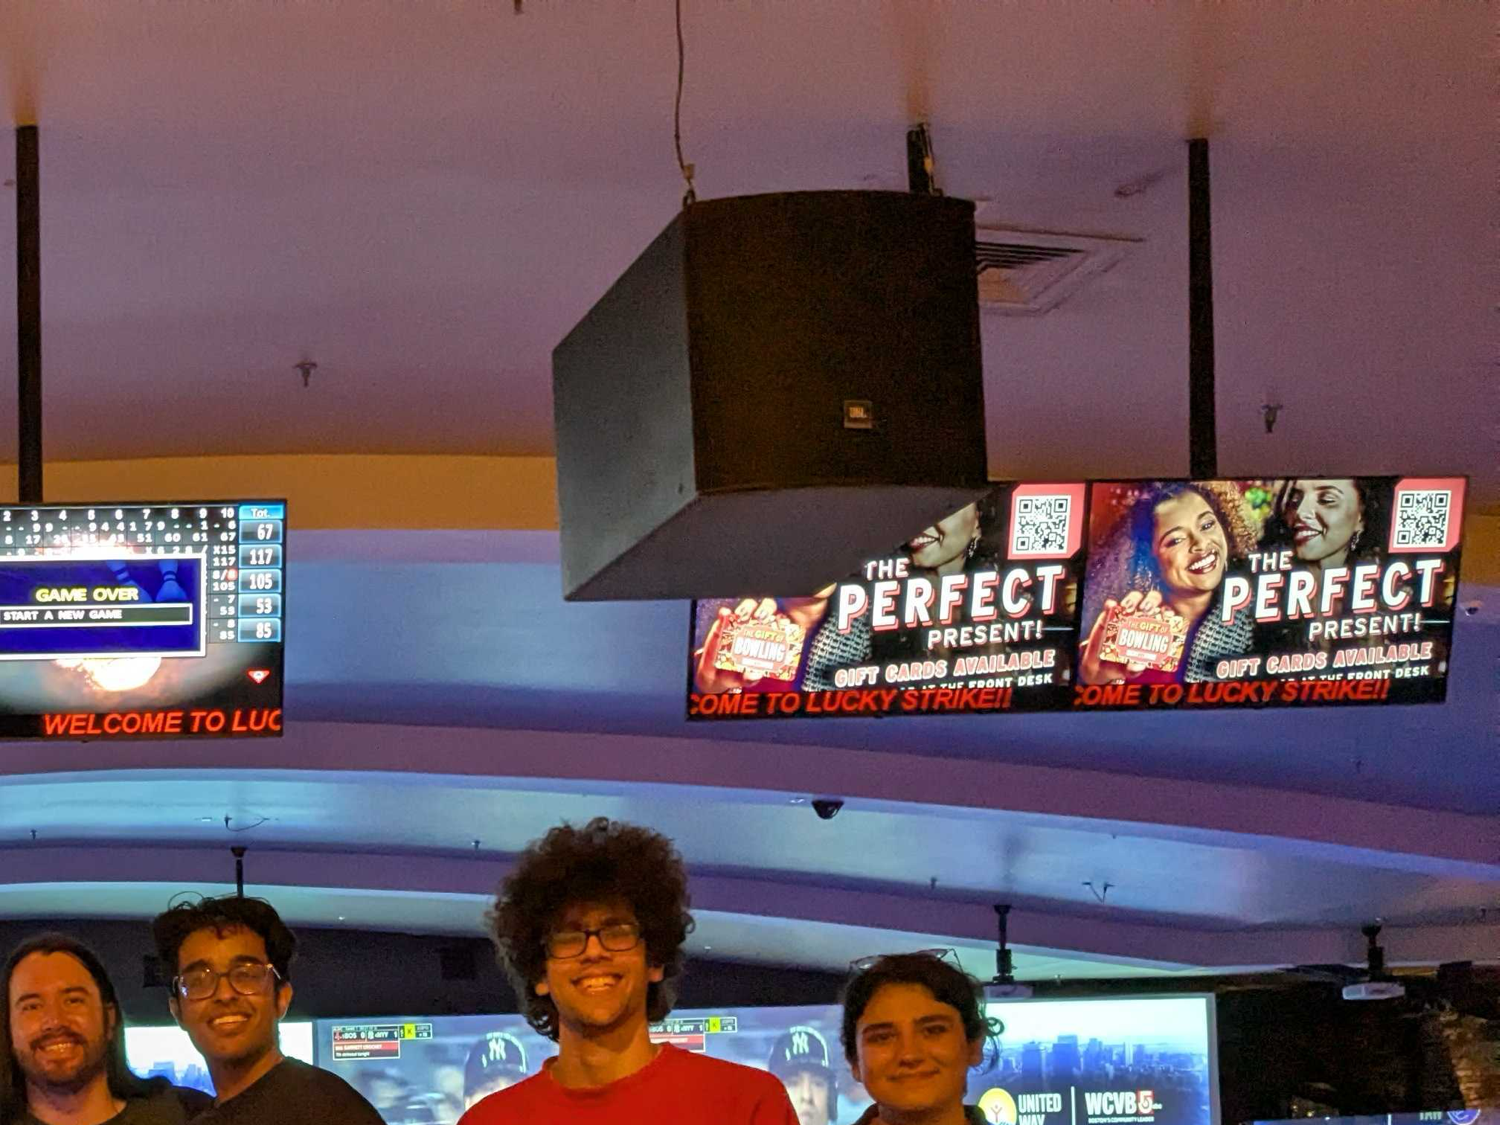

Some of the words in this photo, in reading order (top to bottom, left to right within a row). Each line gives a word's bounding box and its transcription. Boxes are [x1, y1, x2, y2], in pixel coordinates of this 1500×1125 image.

[220, 507, 235, 519] 10
[137, 533, 152, 543] 51
[164, 532, 181, 542] 60
[220, 532, 236, 541] 67
[257, 524, 273, 540] 67
[213, 557, 236, 566] 117
[250, 549, 273, 564] 117
[865, 557, 911, 581] THE
[1250, 550, 1294, 573] THE
[212, 582, 235, 591] 105
[250, 573, 272, 589] 105
[1221, 558, 1445, 626] PERFECT
[35, 588, 88, 602] GAME
[93, 587, 139, 602] OVER
[256, 598, 272, 614] 53
[837, 564, 1067, 635] PERFECT
[3, 611, 39, 621] START
[44, 611, 54, 620] A
[58, 610, 85, 620] NEW
[89, 609, 122, 619] GAME
[1308, 612, 1422, 642] PRESENT!
[256, 622, 271, 638] 85
[927, 619, 1044, 650] PRESENT!
[1119, 628, 1169, 653] BOWLING
[734, 637, 786, 662] BOWLING
[1216, 658, 1261, 680] GIFT
[1266, 652, 1328, 674] CARDS
[1333, 641, 1433, 669] AVAILABLE
[834, 666, 880, 688] GIFT
[885, 659, 948, 683] CARDS
[953, 649, 1056, 677] AVAILABLE
[1018, 673, 1053, 687] DESK
[1395, 665, 1430, 678] DESK
[767, 691, 800, 714] TO
[806, 689, 899, 713] LUCKY
[902, 687, 1013, 711] STRIKE!!
[1149, 684, 1183, 704] TO
[1188, 681, 1276, 703] LUCKY
[1282, 678, 1390, 701] STRIKE!!
[44, 711, 183, 736] WELCOME
[189, 710, 225, 732] TO
[1018, 1093, 1062, 1113] UNITED
[1085, 1091, 1137, 1115] WCVB
[1138, 1090, 1154, 1114] 5
